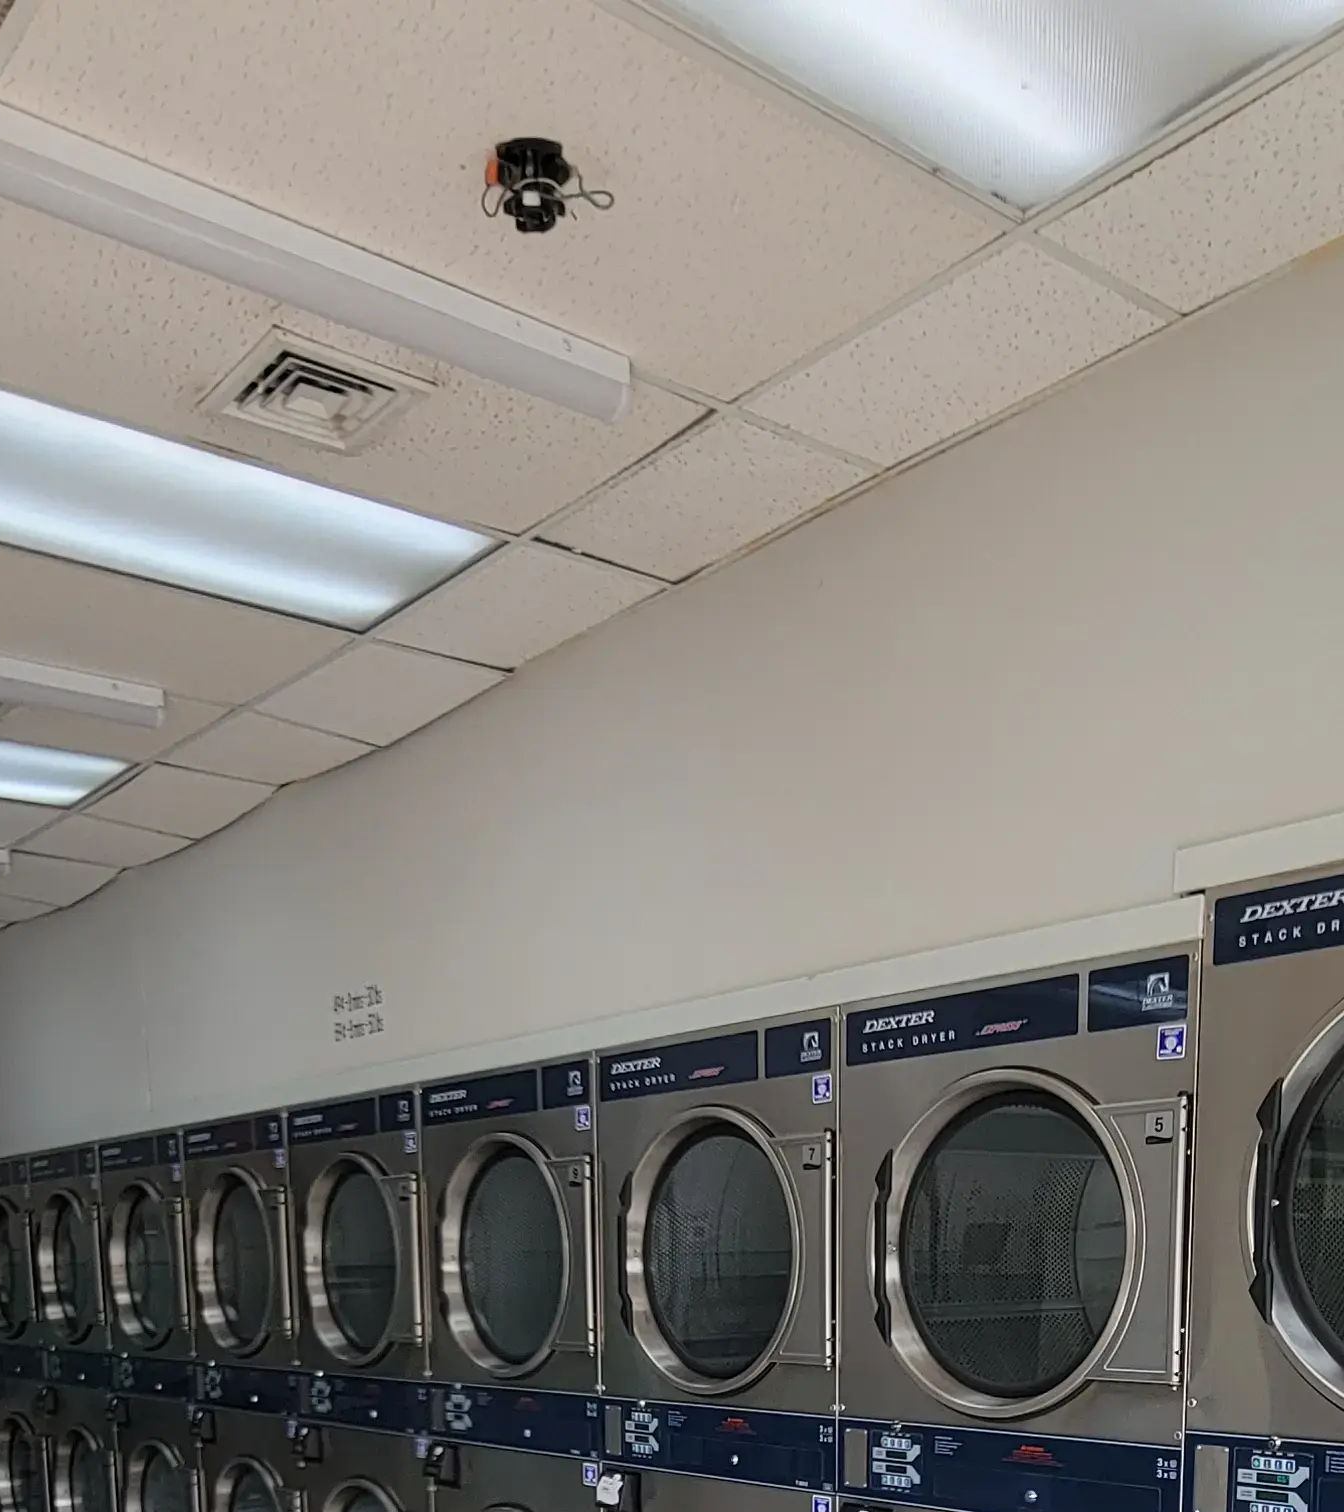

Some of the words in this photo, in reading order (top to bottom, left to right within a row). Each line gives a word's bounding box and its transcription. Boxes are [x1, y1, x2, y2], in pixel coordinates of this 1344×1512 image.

[1238, 926, 1302, 948] STACK
[862, 1010, 936, 1034] DEXTER
[861, 1036, 905, 1053] STACK
[912, 1029, 956, 1046] DRYER
[610, 1057, 661, 1076] DEXTER
[1154, 1117, 1164, 1132] 5
[808, 1147, 816, 1161] 7
[1156, 1458, 1163, 1467] 3
[1156, 1469, 1163, 1479] 3
